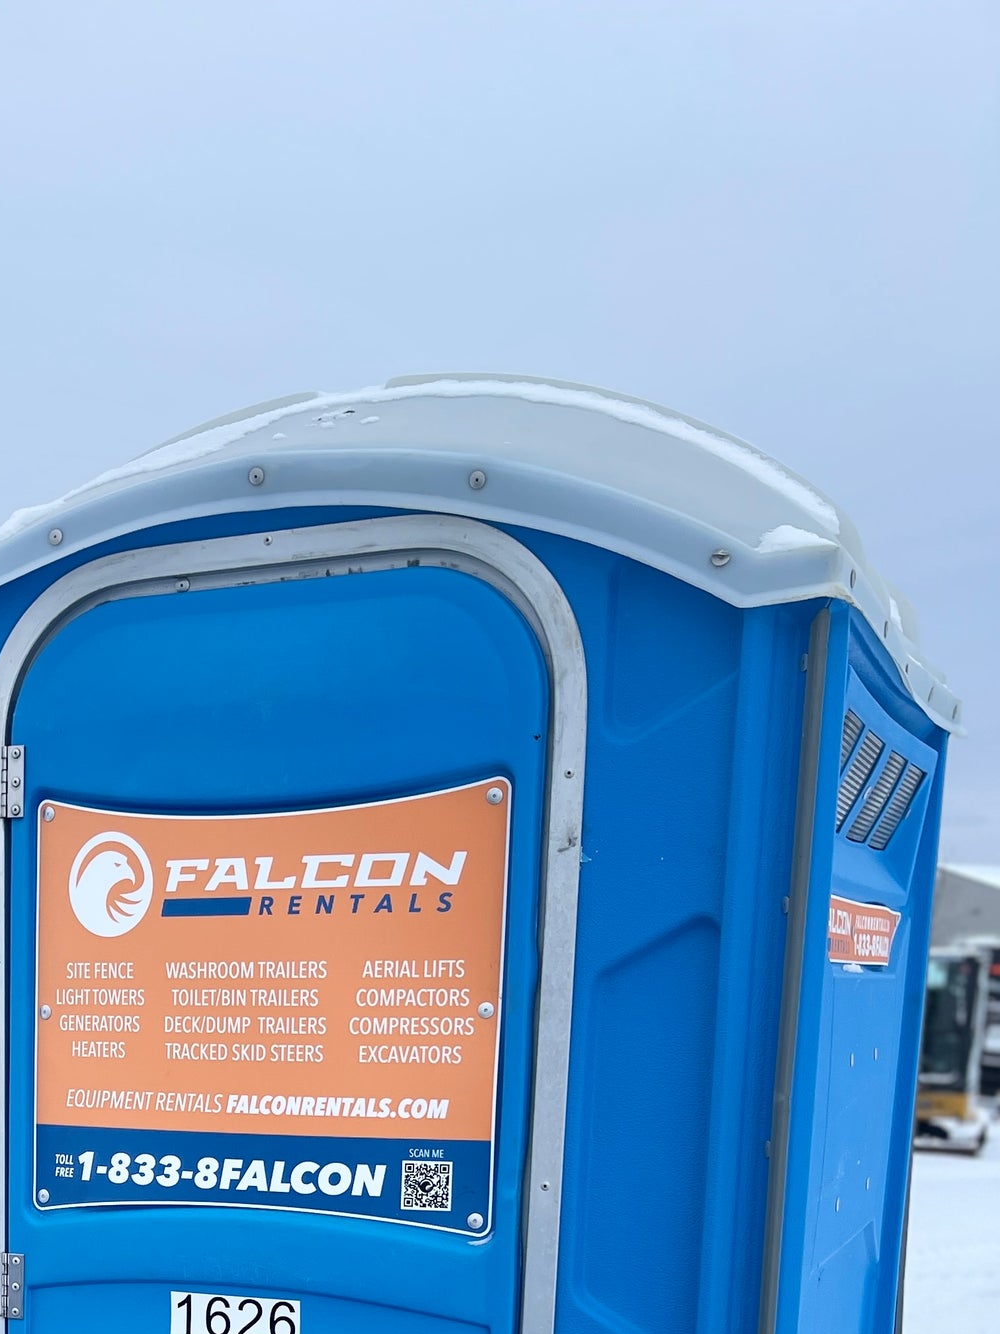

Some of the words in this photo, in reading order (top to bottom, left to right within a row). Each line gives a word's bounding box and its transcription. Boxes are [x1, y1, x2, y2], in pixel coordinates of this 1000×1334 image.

[165, 851, 468, 892] FALCON
[258, 892, 453, 916] RENTALS
[829, 907, 852, 936] ALCON
[66, 963, 90, 979] SITE
[93, 963, 135, 980] FENCE
[165, 961, 254, 979] WASHROOM
[257, 960, 328, 979] TRAILERS
[362, 960, 419, 979] AERIAL
[423, 959, 466, 979] LIFTS
[55, 989, 91, 1007] LIGHT
[92, 989, 145, 1007] TOWERS
[171, 989, 247, 1007] TOILET/BIN
[250, 988, 319, 1008] TRAILERS
[355, 988, 470, 1008] COMPACTORS
[59, 1015, 141, 1033] GENERATORS
[164, 1016, 252, 1035] DECK/DUMP
[257, 1016, 327, 1035] TRAILERS
[348, 1017, 475, 1036] COMPRESSORS
[71, 1041, 126, 1059] HEATERS
[165, 1043, 227, 1061] TRACKED
[231, 1044, 266, 1062] SKID
[269, 1044, 324, 1063] STEERS
[358, 1045, 463, 1065] EXCAVATORS
[66, 1089, 154, 1111] EQUIPMENT
[155, 1092, 223, 1113] RENTALS
[226, 1094, 450, 1120] FALCONRENTALS.COM
[55, 1154, 75, 1166] TOLL
[409, 1149, 431, 1159] SCAN
[432, 1149, 444, 1159] ME
[55, 1167, 75, 1179] FREE
[77, 1151, 387, 1197] 1-833-8FALCON
